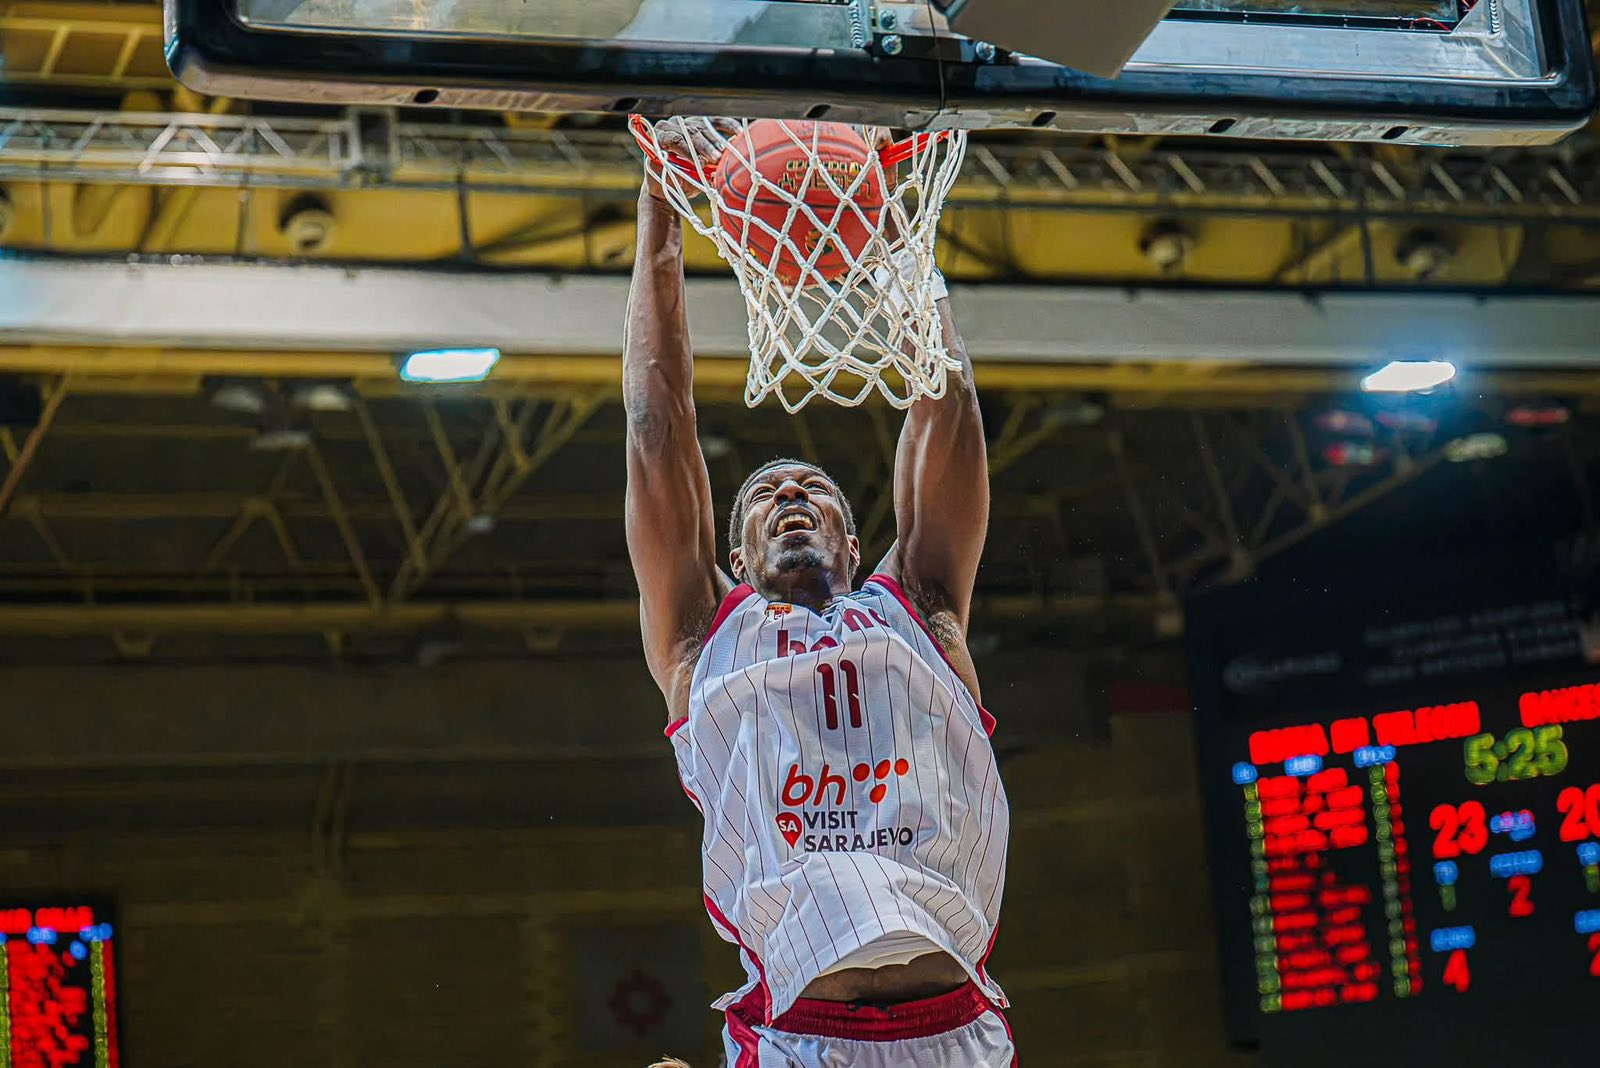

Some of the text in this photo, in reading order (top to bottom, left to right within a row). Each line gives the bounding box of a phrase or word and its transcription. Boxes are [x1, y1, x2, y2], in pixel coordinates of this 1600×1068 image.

[816, 659, 862, 731] 11
[1463, 724, 1568, 785] 5:25
[782, 763, 846, 807] bh
[779, 819, 798, 833] SA
[803, 810, 858, 830] VISIT
[804, 826, 913, 853] SARAJEVO
[1430, 800, 1488, 857] 23
[1508, 874, 1535, 917] 2
[1443, 948, 1471, 993] 4
